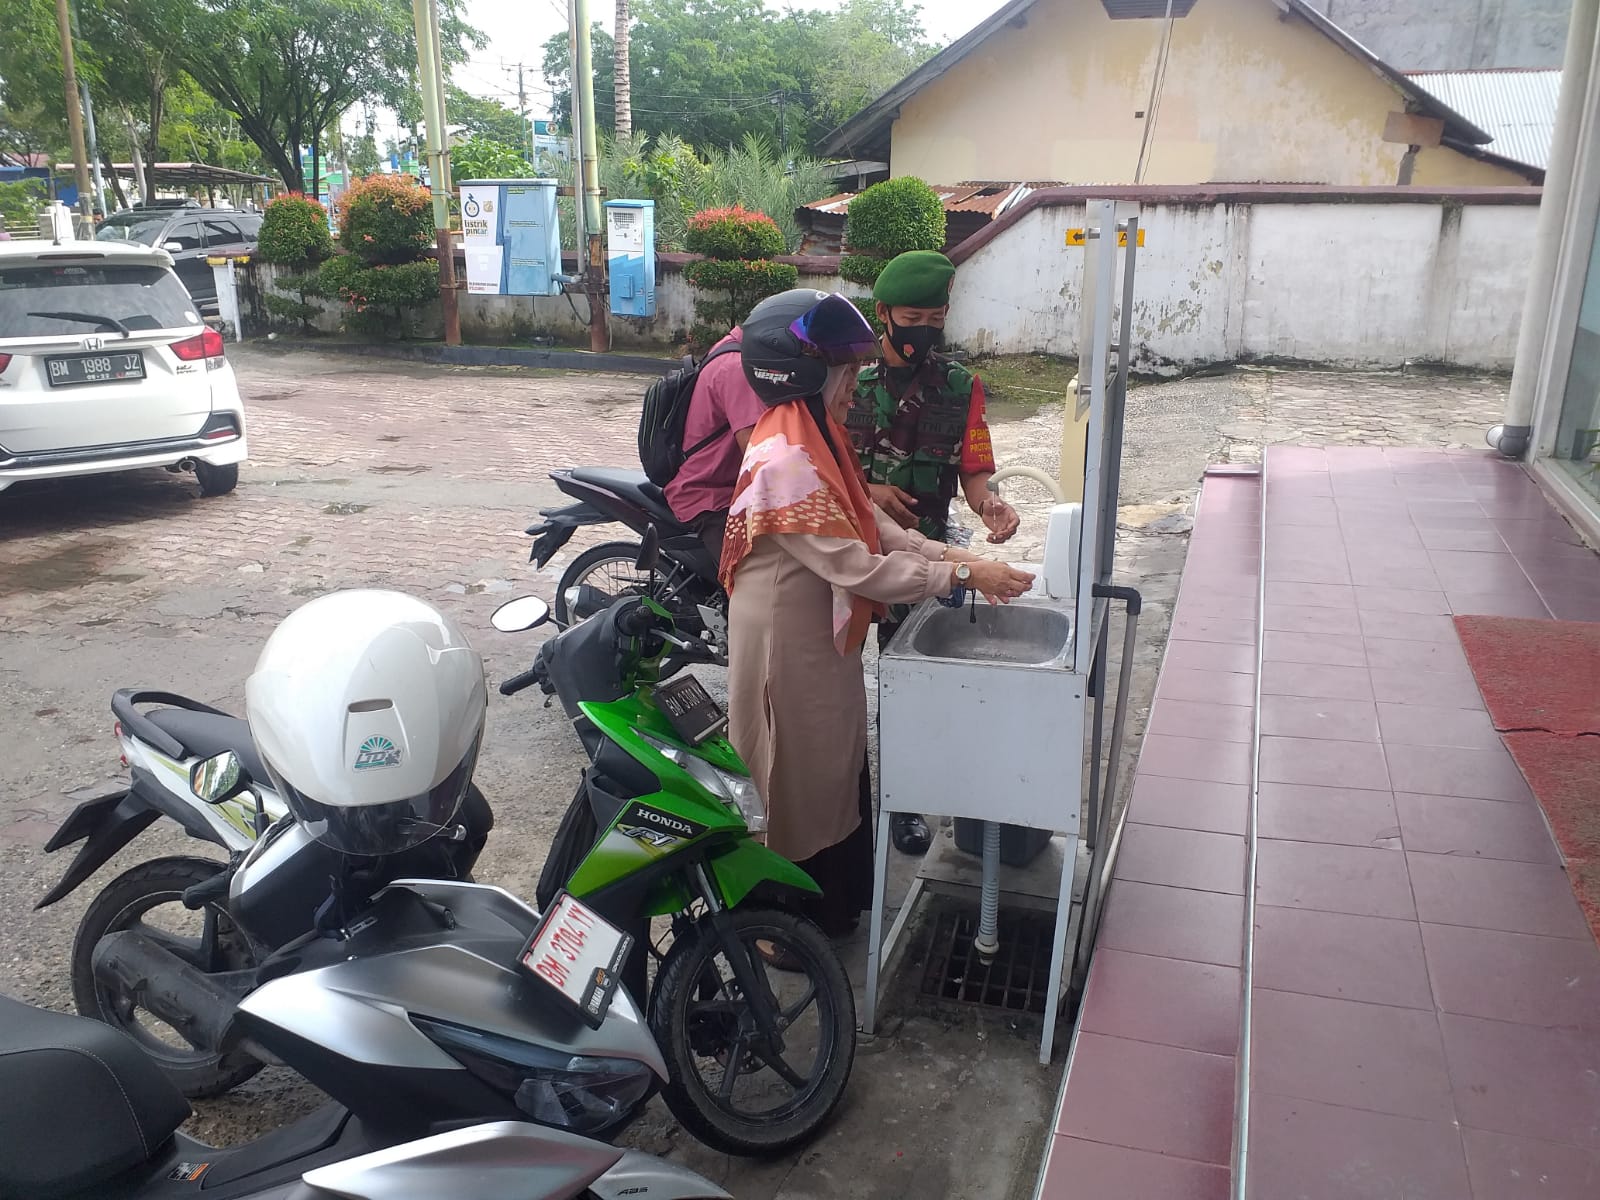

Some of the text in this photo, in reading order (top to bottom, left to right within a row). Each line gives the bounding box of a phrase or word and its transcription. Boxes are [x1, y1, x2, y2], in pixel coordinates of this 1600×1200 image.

[464, 219, 488, 228] listrik
[465, 228, 488, 237] pintar
[50, 353, 140, 377] BM 1988 JZ
[636, 808, 693, 834] HONDA
[536, 903, 596, 987] BM 3704 YY
